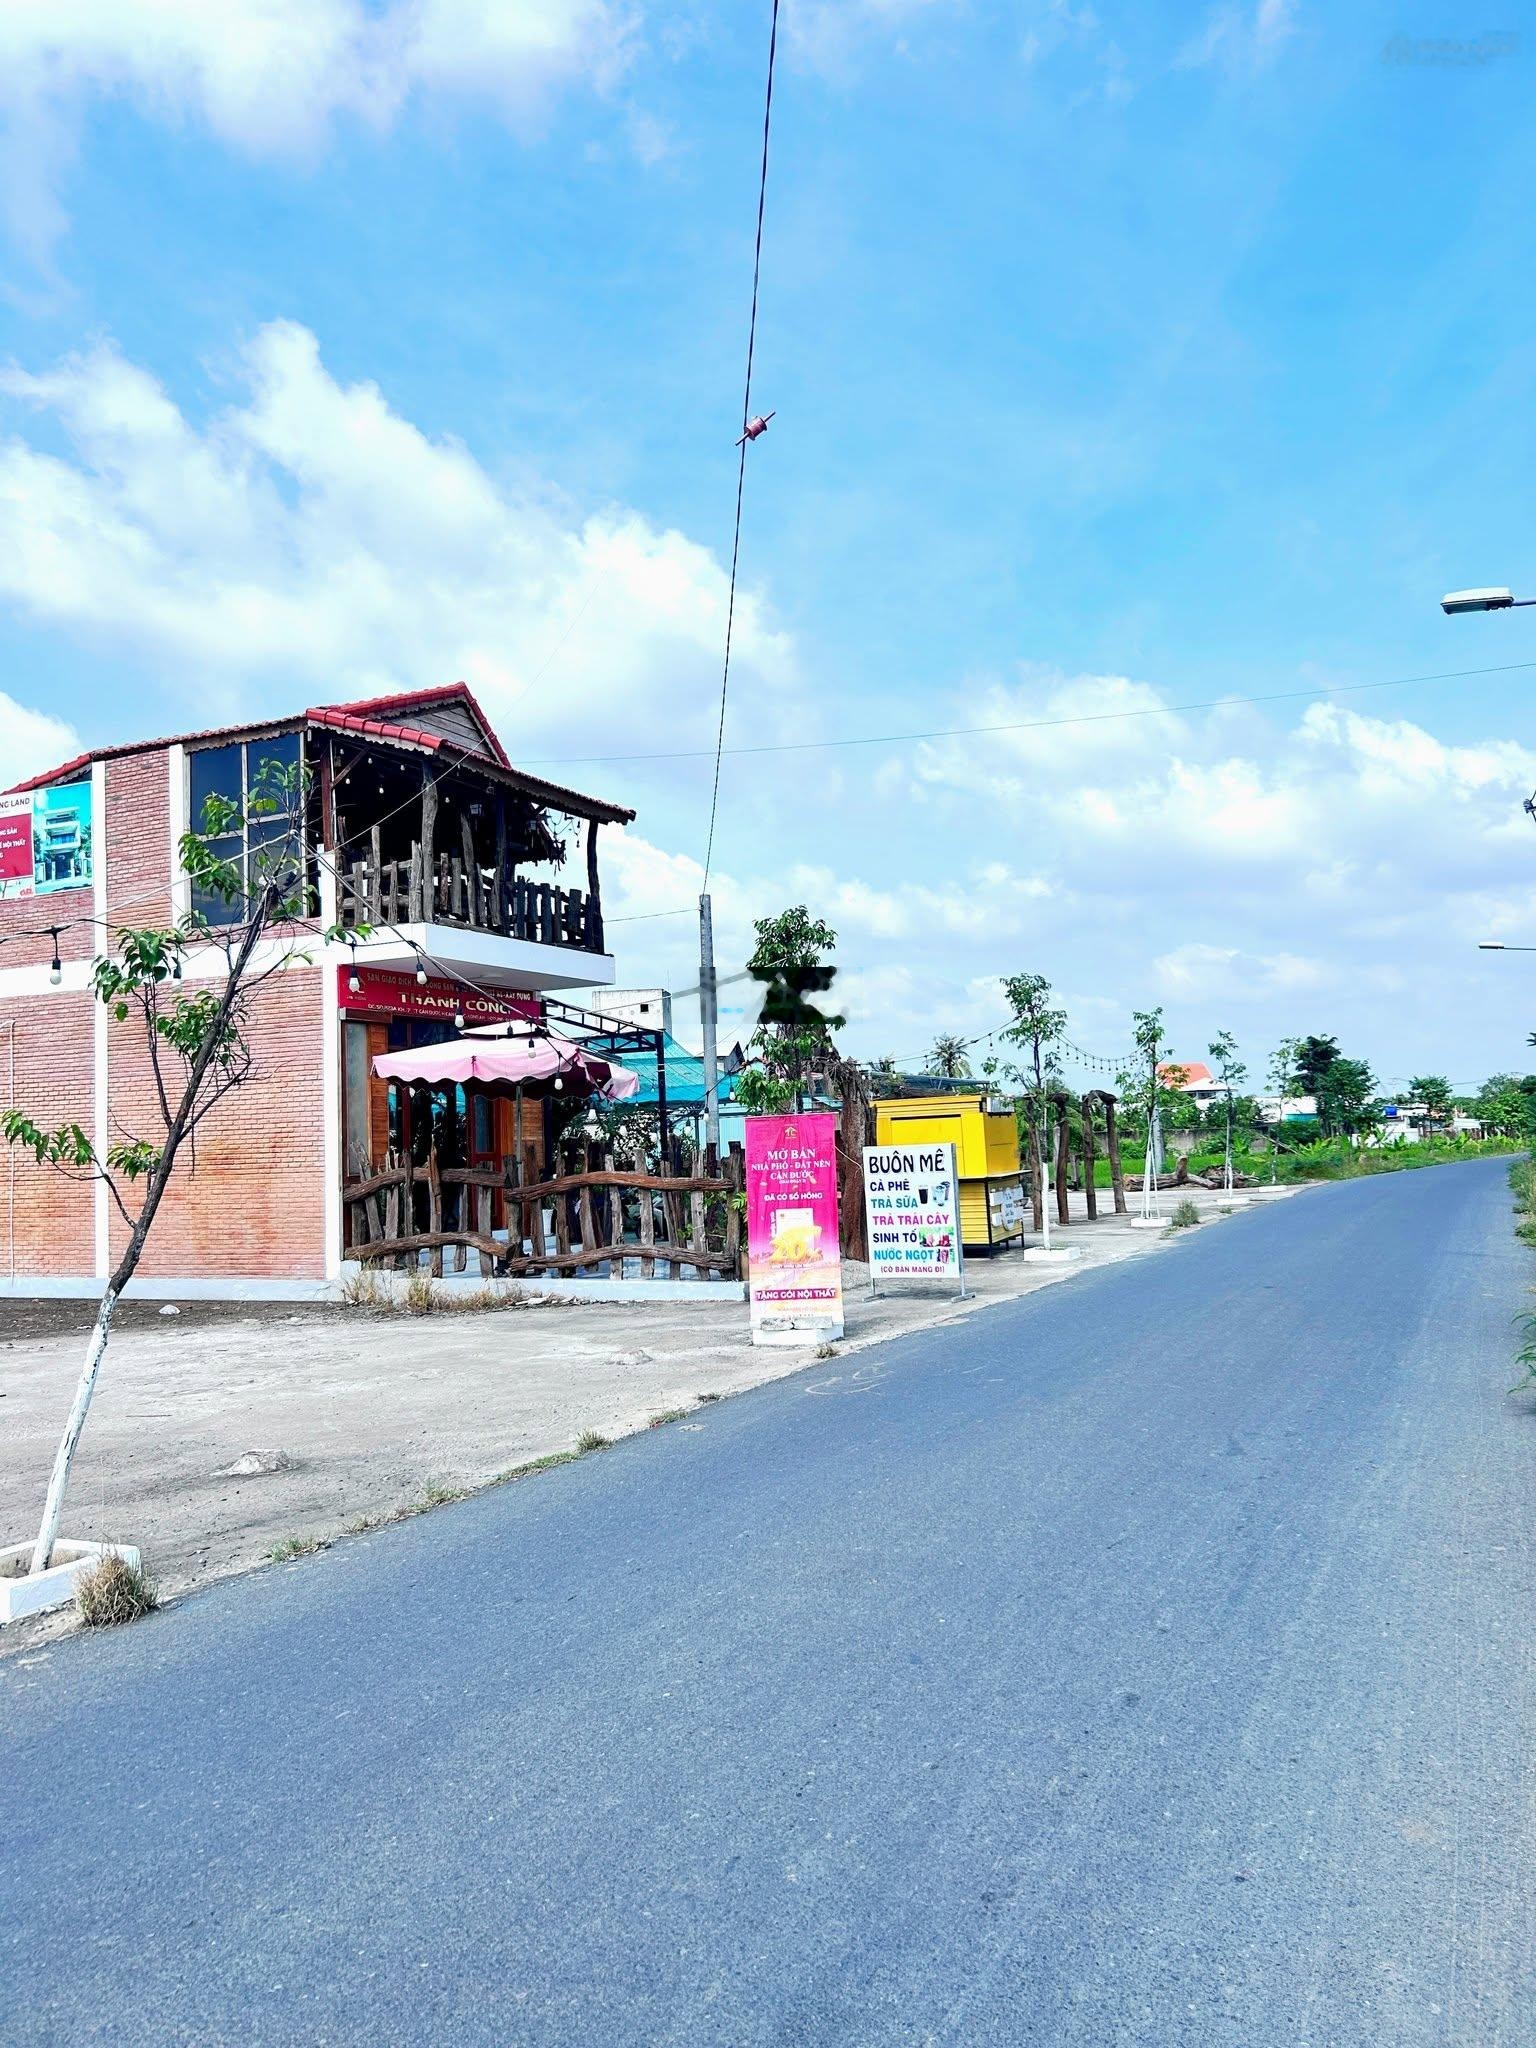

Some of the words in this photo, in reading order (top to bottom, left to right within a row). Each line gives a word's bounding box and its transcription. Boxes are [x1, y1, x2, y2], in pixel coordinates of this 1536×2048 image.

[10, 798, 30, 807] LAND
[382, 975, 397, 985] GIAO
[767, 1148, 789, 1161] MỞ
[790, 1147, 816, 1159] BÁN
[868, 1150, 915, 1174] BUÔN
[919, 1148, 946, 1173] MÊ
[751, 1161, 769, 1171] NHÀ
[771, 1161, 789, 1170] PHỐ
[870, 1178, 885, 1192] CÀ
[888, 1178, 911, 1191] PHÊ
[776, 1192, 787, 1201] CÓ
[870, 1195, 893, 1209] TRÀ
[896, 1194, 919, 1209] SỮA
[872, 1211, 894, 1226] TRÀ
[897, 1211, 924, 1226] TRÁI
[926, 1211, 950, 1225] CÂY
[872, 1232, 900, 1243] SINH
[902, 1228, 918, 1243] TỐ
[873, 1247, 903, 1261] NƯỚC
[905, 1249, 935, 1264] NGỌT
[912, 1265, 934, 1274] MANG
[755, 1289, 780, 1301] TẶNG
[780, 1289, 796, 1300] GÓI
[797, 1288, 813, 1300] NỘI
[814, 1286, 836, 1298] THẤT
